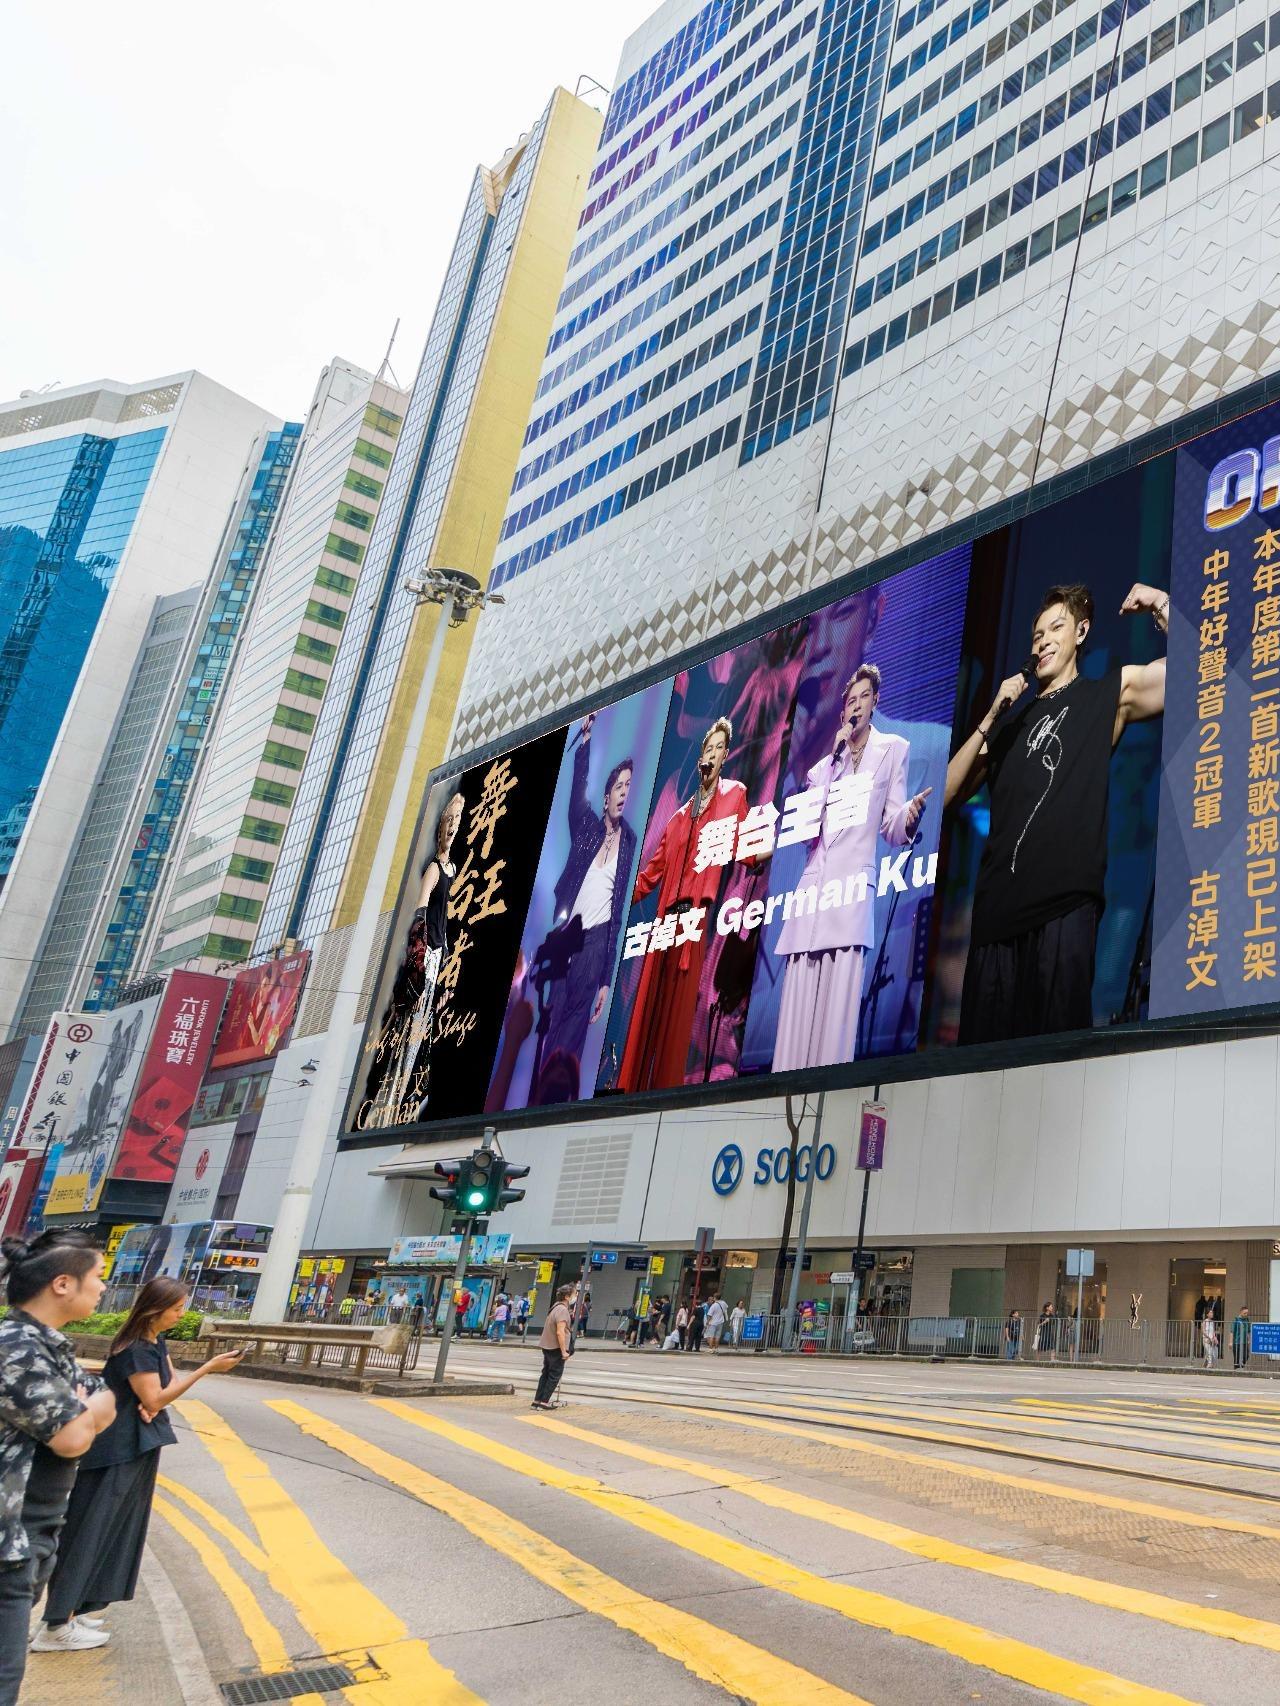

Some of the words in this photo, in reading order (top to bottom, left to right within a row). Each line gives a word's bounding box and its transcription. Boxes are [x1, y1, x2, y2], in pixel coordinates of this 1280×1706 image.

[1193, 548, 1230, 829] 中年好聲音2冠軍
[693, 771, 875, 874] 舞台王者
[716, 871, 868, 936] German
[877, 850, 938, 897] Ku
[1185, 870, 1220, 991] 古淖文
[166, 997, 200, 1065] 六福珠寶
[433, 1006, 477, 1046] Stage
[754, 1143, 835, 1185] SOGO
